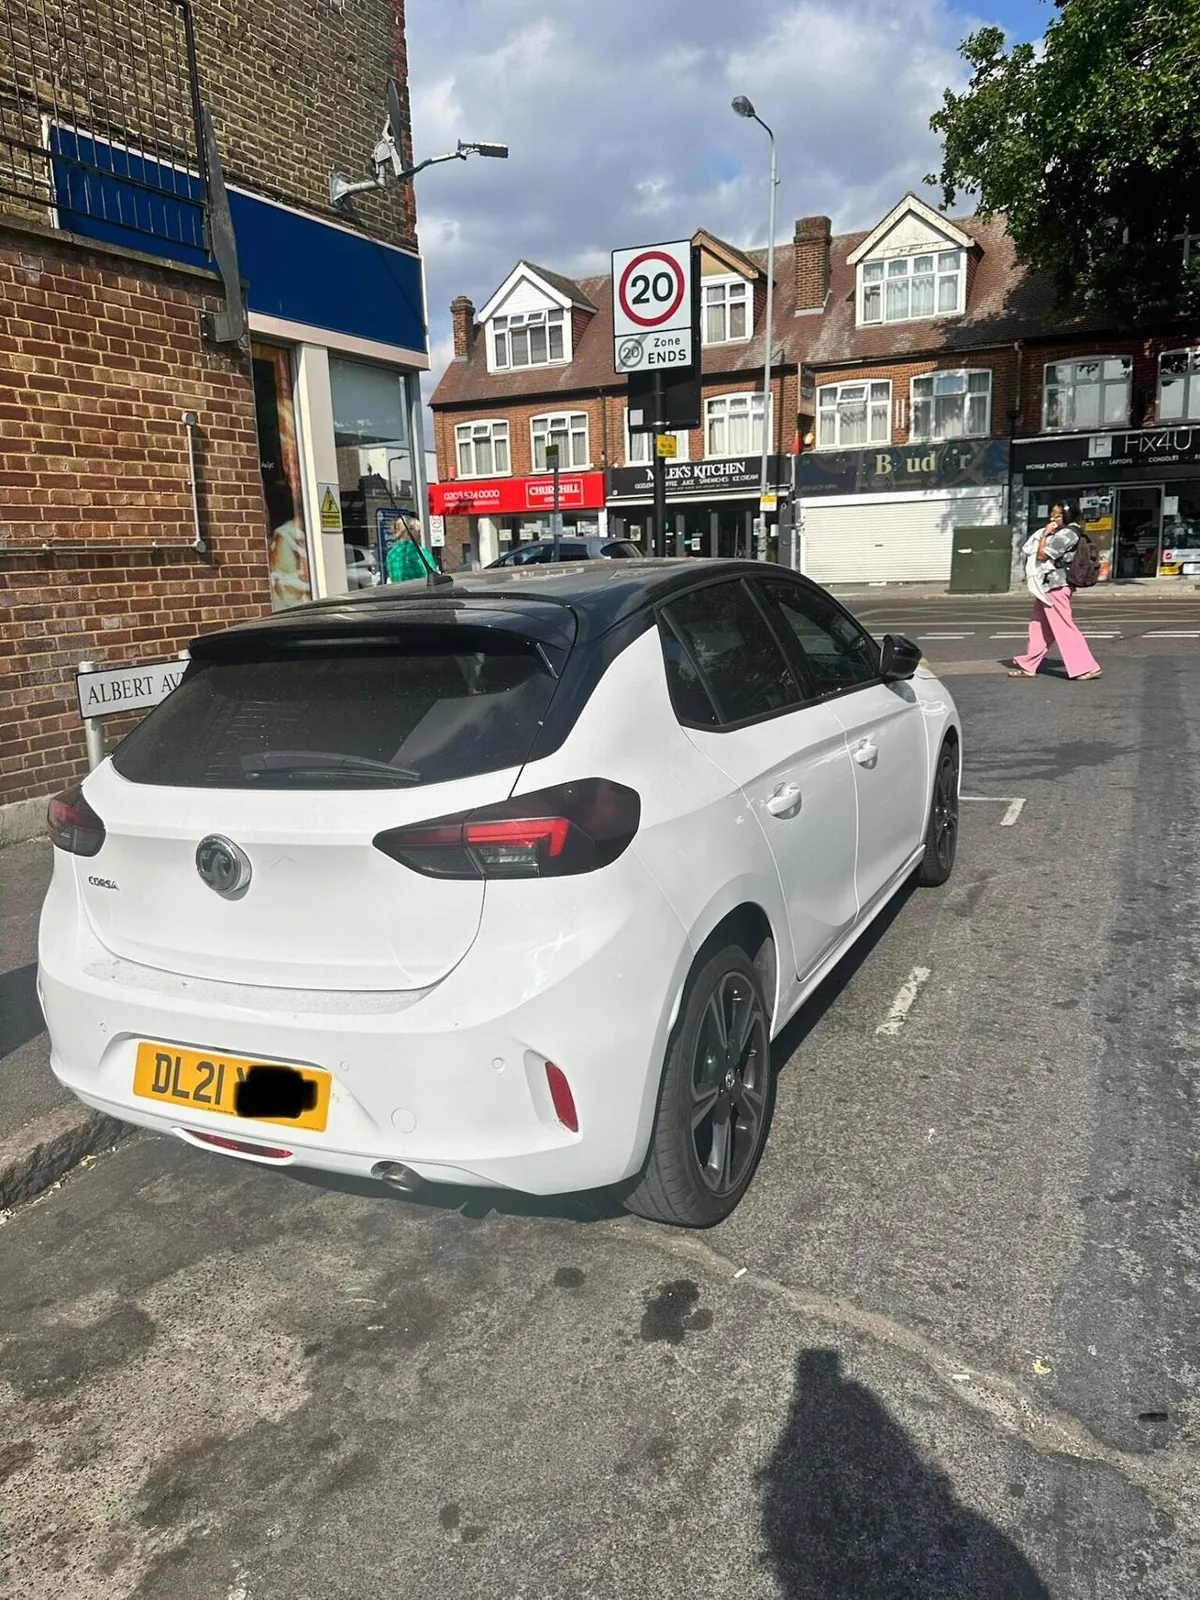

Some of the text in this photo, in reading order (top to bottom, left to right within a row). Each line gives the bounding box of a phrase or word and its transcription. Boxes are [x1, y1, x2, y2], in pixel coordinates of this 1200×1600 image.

[631, 272, 674, 305] 20
[654, 337, 681, 348] Zone
[623, 346, 640, 359] 20
[648, 349, 687, 364] ENDS
[1046, 461, 1067, 469] PHONES
[1109, 458, 1133, 466] LAPTOPS
[1148, 455, 1179, 463] CONSOLES
[645, 461, 746, 481] MLEK'S KITCHEN
[529, 484, 580, 495] CHURHILL
[88, 671, 184, 704] ALBERT AV
[88, 875, 120, 891] CORSA
[152, 1053, 225, 1105] DL21
